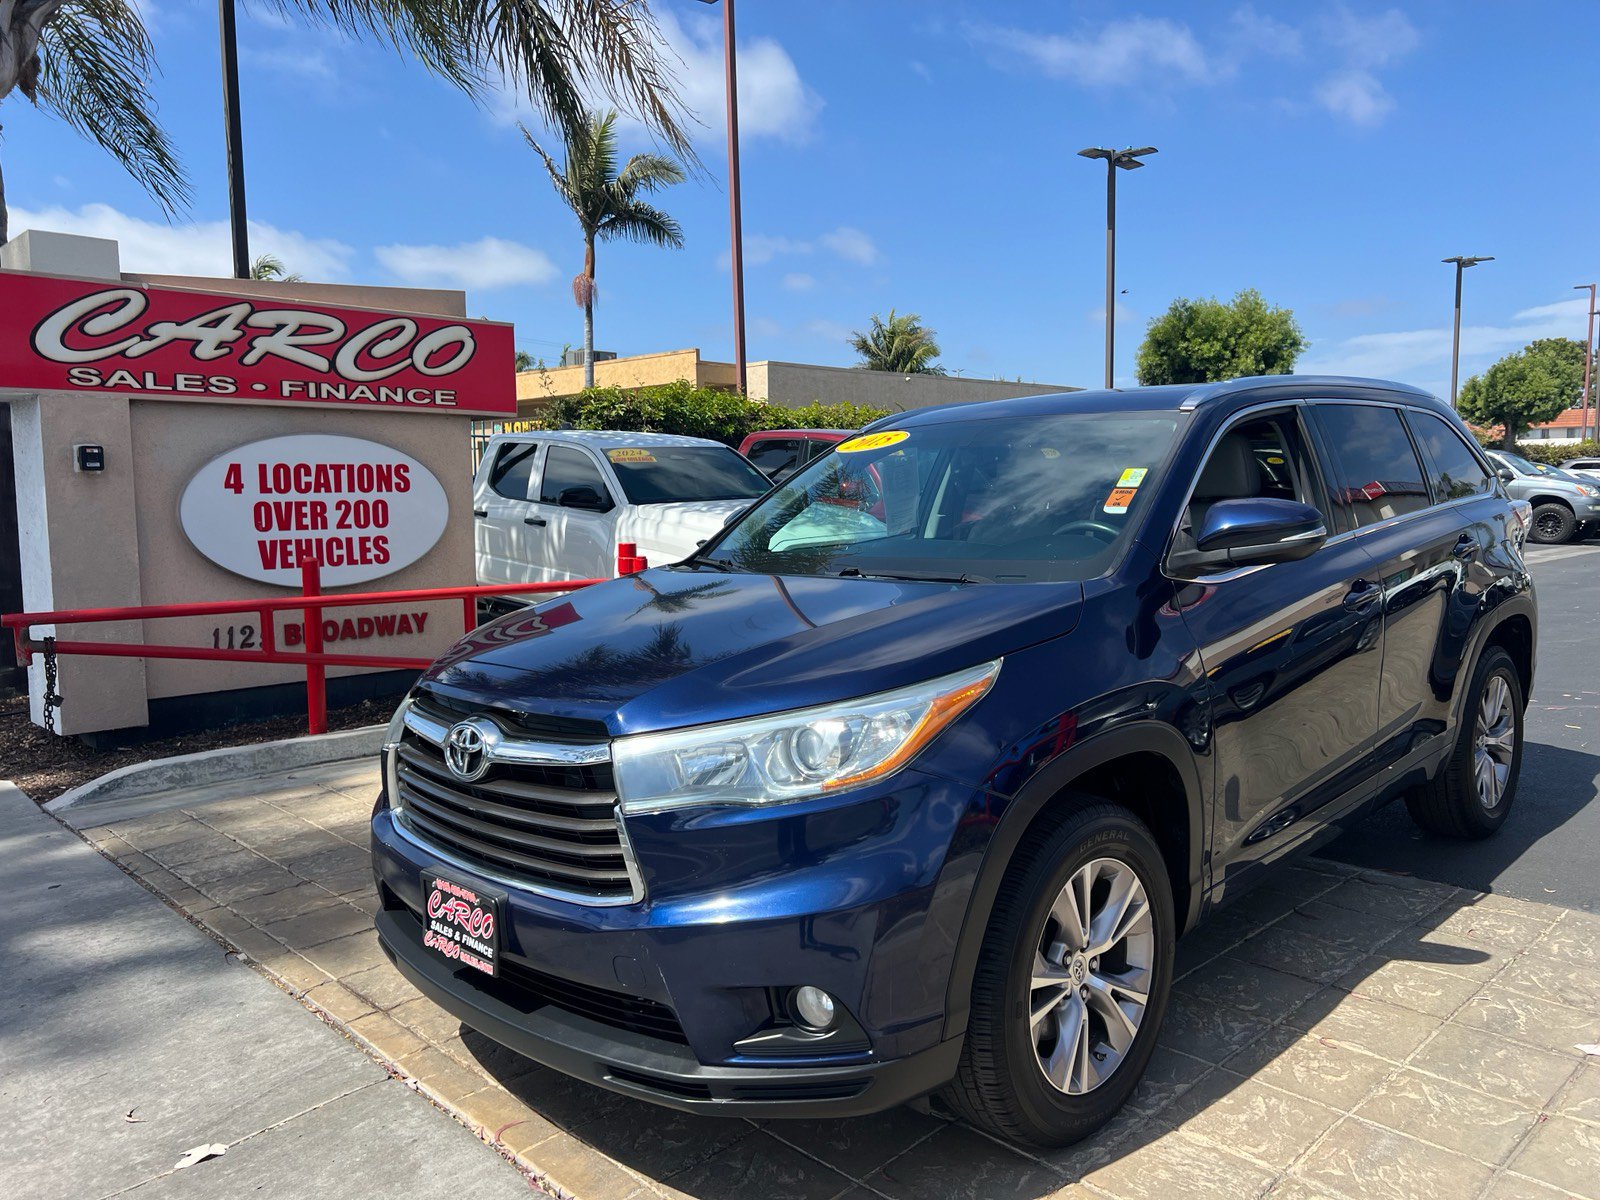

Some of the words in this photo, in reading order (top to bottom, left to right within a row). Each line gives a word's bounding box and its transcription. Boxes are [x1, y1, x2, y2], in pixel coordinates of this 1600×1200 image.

[32, 288, 477, 383] CARCO
[67, 366, 238, 394] SALES
[281, 380, 458, 406] FINANCE
[223, 463, 244, 495] 4
[258, 463, 411, 495] LOCATIONS
[253, 500, 328, 534] OVER
[335, 499, 390, 531] 200
[257, 535, 391, 571] VEHICLES
[212, 625, 264, 650] 112
[284, 612, 429, 647] BOADWAY
[1079, 830, 1130, 854] GENERAL
[427, 889, 495, 940] CARCO
[430, 920, 454, 938] SALES
[453, 930, 461, 942] &
[461, 933, 494, 959] FINANCE
